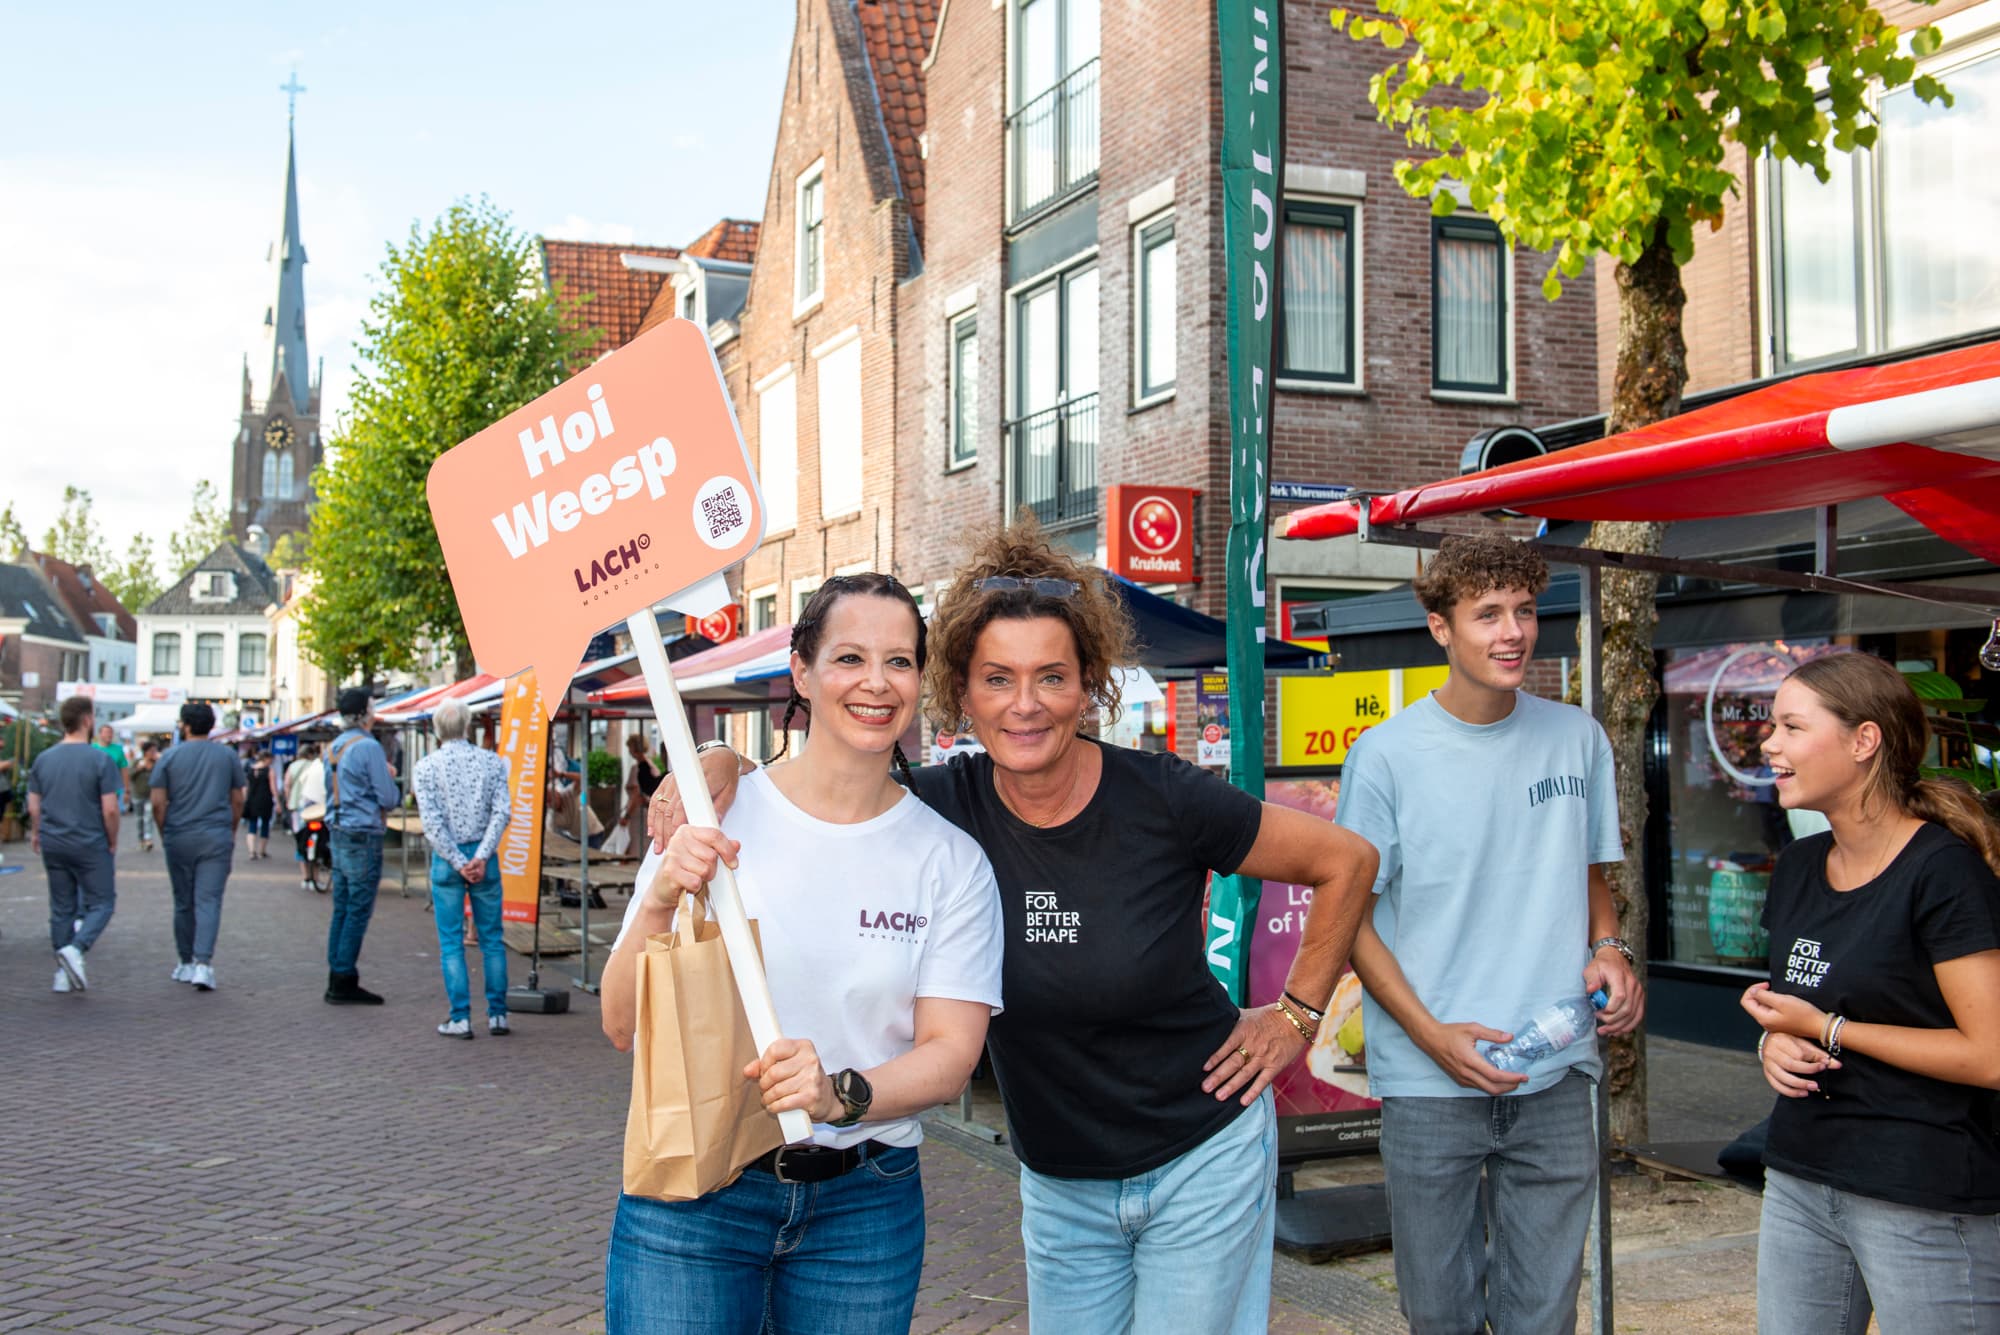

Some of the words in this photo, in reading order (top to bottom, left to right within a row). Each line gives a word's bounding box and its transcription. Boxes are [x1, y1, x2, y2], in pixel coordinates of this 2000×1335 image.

[517, 383, 615, 479] Hoi
[491, 436, 678, 559] Weesp
[1129, 555, 1181, 573] Kruidvat
[1305, 730, 1336, 756] ZO
[1343, 725, 1373, 751] G
[1025, 895, 1058, 911] FOR
[1026, 911, 1082, 928] BETTER
[1268, 911, 1293, 934] of
[1025, 927, 1078, 943] SHAPE
[1793, 941, 1820, 958] FOR
[1788, 954, 1830, 975] BETTER
[1785, 968, 1824, 988] SHAPE
[1338, 1131, 1362, 1142] Code:
